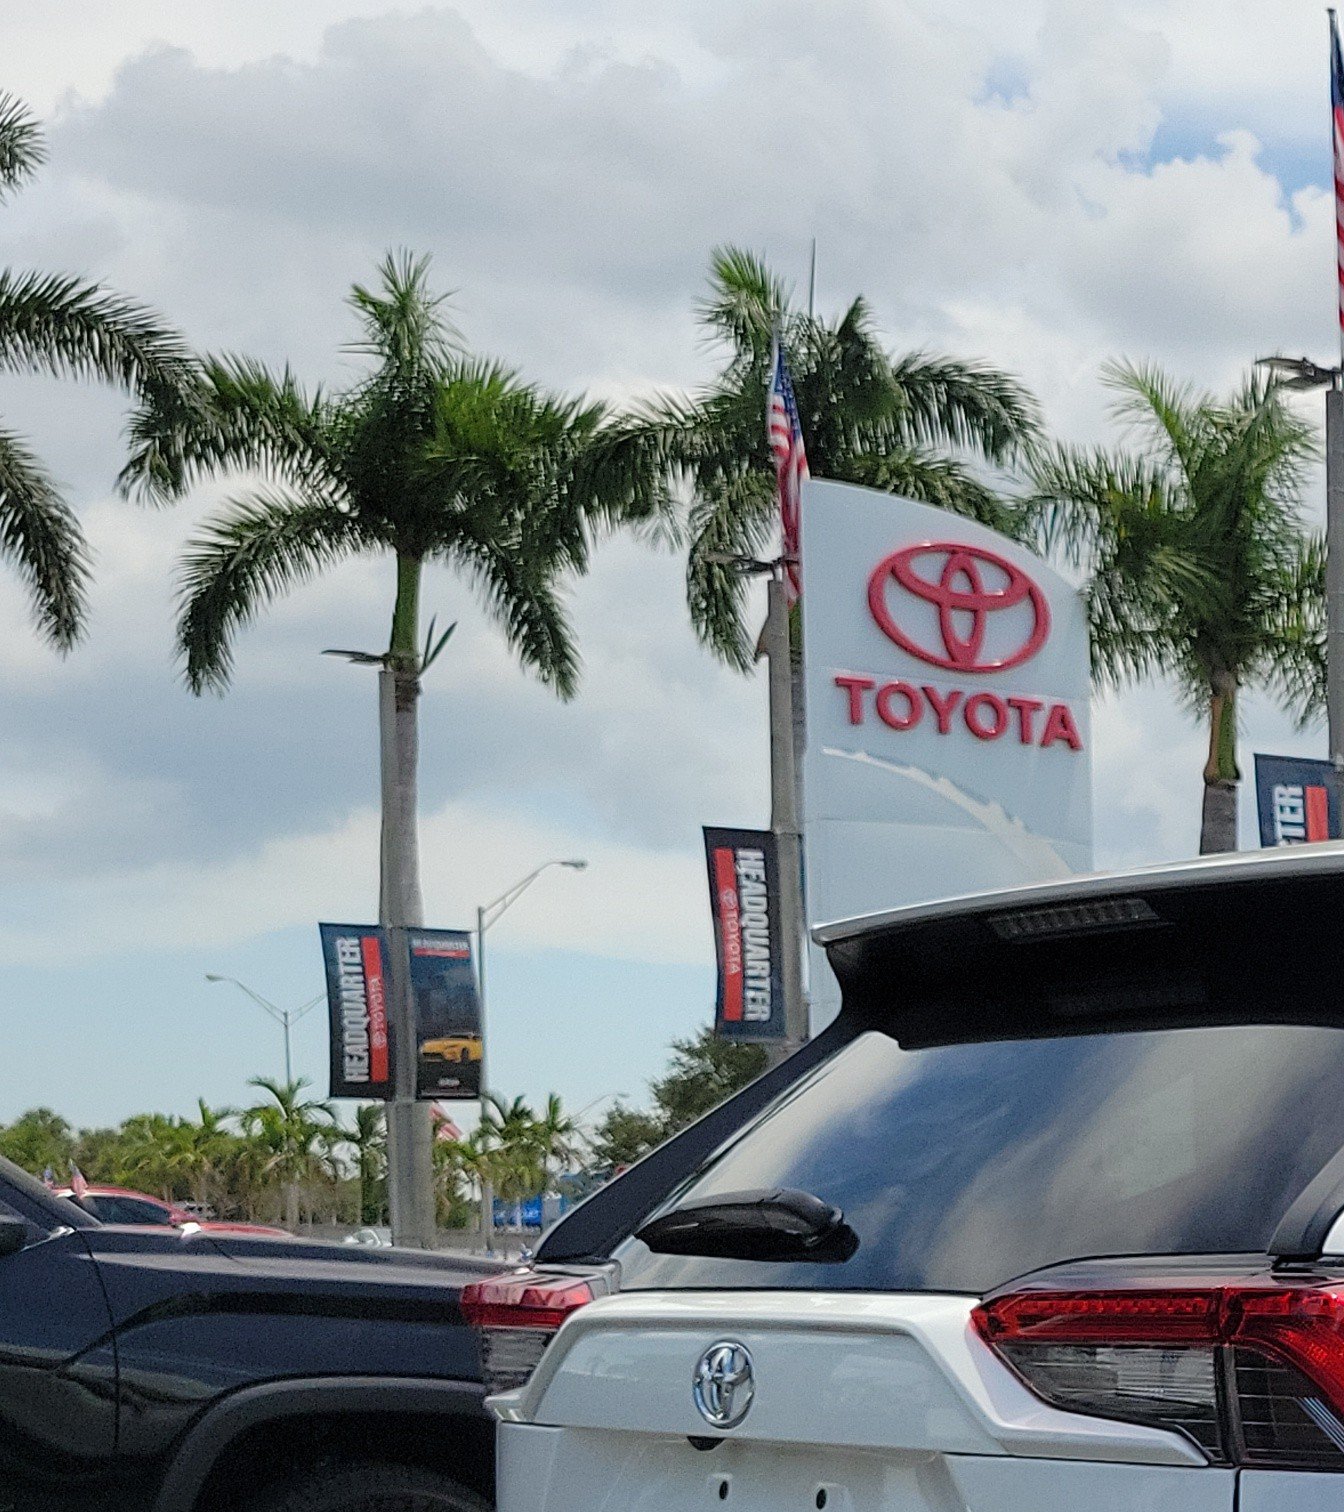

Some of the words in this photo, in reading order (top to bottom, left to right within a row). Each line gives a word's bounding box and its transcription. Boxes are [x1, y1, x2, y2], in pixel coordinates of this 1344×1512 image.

[834, 676, 1082, 751] TOYOTA
[725, 911, 741, 975] TOYOTA
[735, 848, 771, 1021] HEADQUARTER
[336, 936, 370, 1083] HEADQUARTER
